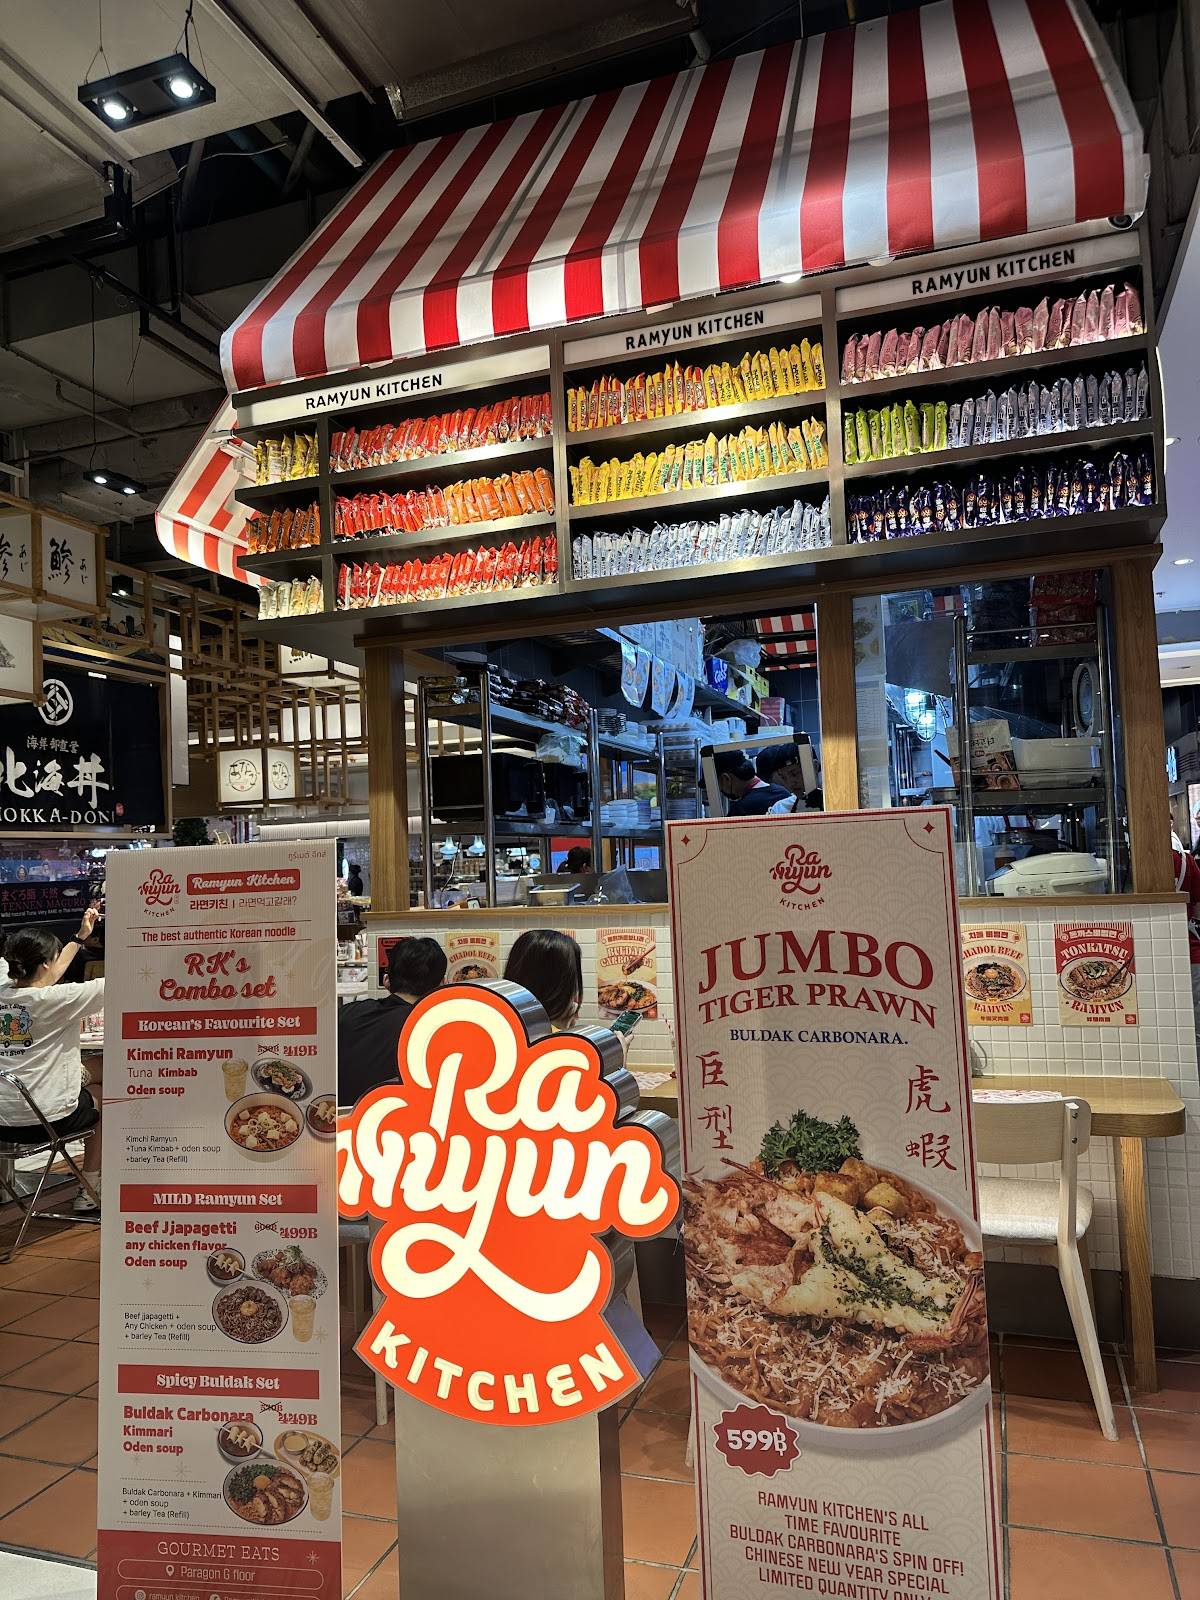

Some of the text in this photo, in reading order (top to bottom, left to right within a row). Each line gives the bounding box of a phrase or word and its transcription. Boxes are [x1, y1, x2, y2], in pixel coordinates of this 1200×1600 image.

[912, 248, 1075, 295] RAMYUN KITCHEN
[625, 310, 764, 350] RAMYUN KITCHEN
[305, 373, 442, 410] RAMYUN KITCHEN
[785, 844, 821, 867] Ra
[150, 869, 174, 885] Ra
[192, 873, 296, 891] Ramyun Kitchen
[190, 898, 228, 910] 라면키친
[780, 897, 825, 911] KITCHEN
[144, 907, 175, 918] KITCHEN
[142, 926, 296, 942] The best authentic Korean noodle
[963, 945, 996, 959] HADOL
[1061, 943, 1128, 959] TONKATSU
[184, 950, 252, 977] RK's
[699, 930, 934, 995] JUMBO
[159, 975, 277, 1001] Combo set
[699, 982, 937, 1029] TIGER PRAWN
[1071, 1000, 1124, 1014] RAMYUN
[138, 1016, 300, 1032] Korean's Favourite Set
[730, 1028, 908, 1045] BULDAK CARBONARA.
[127, 1047, 233, 1062] Kimchi Ramyun
[283, 1045, 318, 1056] 419B
[128, 1067, 197, 1078] Tuna Kimbab
[406, 998, 606, 1143] Ra
[127, 1085, 185, 1097] Oden soup
[150, 1135, 178, 1143] Ramyun
[202, 1145, 221, 1153] soup
[153, 1155, 165, 1163] Tea
[153, 1193, 282, 1207] MILD Ramyun Set
[125, 1220, 237, 1236] Beef Jjapagetti
[280, 1227, 318, 1239] 499B
[125, 1239, 228, 1252] any chicken flavor
[124, 1256, 188, 1270] Oden soup
[124, 1312, 140, 1320] Beef
[125, 1322, 217, 1332] Any Chicken oden soup
[131, 1333, 152, 1341] barley
[154, 1332, 166, 1340] Tea
[369, 1319, 624, 1414] KITCHEN
[157, 1374, 280, 1390] Spicy Buldak Set
[123, 1405, 254, 1423] Buldak Carbonara
[123, 1425, 173, 1438] Kimmari
[123, 1441, 184, 1456] Oden soup
[122, 1487, 222, 1499] Buldak Carbonara Kimmari
[129, 1499, 169, 1508] oden soup
[758, 1491, 929, 1531] RAMYUN KITCHEN'S ALL
[129, 1509, 151, 1518] barley
[152, 1509, 166, 1518] Tea
[784, 1514, 901, 1547] TIME FAVOURITE
[157, 1541, 280, 1561] GOURMET EATS
[730, 1524, 964, 1577] BULDAK CARBONARA'S SPIN OFF!
[180, 1565, 256, 1581] Paragon G floor
[745, 1546, 950, 1594] CHINESE NEW YEAR SPECIAL
[758, 1567, 813, 1591] LIMITED
[818, 1578, 889, 1600] QUANTITY
